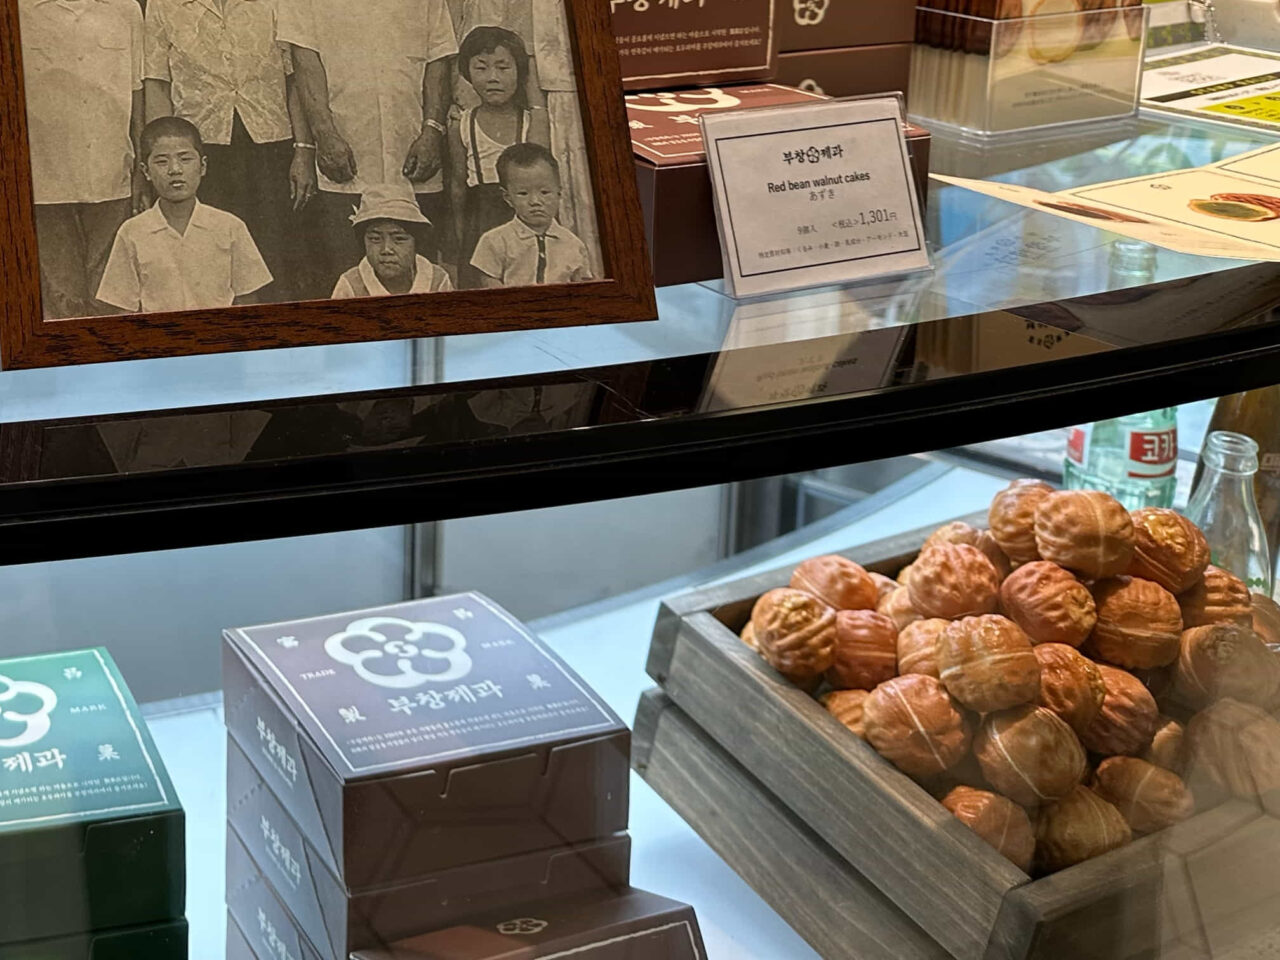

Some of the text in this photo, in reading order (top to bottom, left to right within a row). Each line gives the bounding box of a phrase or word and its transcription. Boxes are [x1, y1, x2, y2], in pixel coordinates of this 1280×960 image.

[768, 171, 871, 193] Red bean walnut cakes
[300, 668, 336, 681] TRADE
[70, 703, 107, 715] MARK
[387, 679, 503, 716] 부창제과
[255, 716, 298, 783] 부창제과
[260, 814, 302, 886] 부창제과
[257, 906, 295, 960] 부창제
